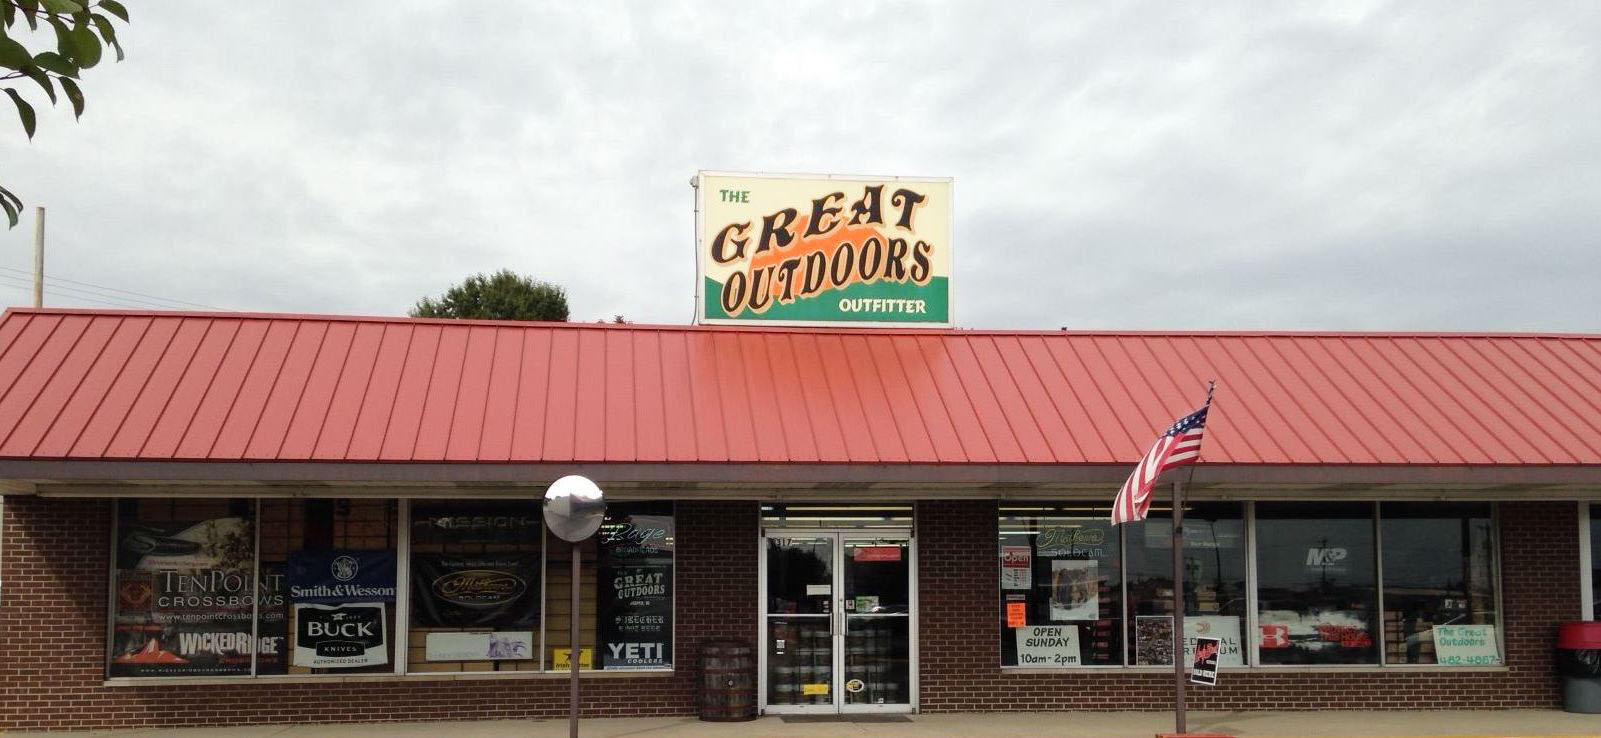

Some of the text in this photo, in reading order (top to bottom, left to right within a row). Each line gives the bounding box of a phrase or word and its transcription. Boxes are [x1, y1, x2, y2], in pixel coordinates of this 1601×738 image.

[720, 189, 750, 203] THE
[711, 185, 926, 263] GREAT
[722, 237, 931, 313] OUTDOORS
[839, 298, 928, 314] OUTFITTER
[614, 573, 663, 589] GREAT
[618, 585, 665, 599] OUTDOORS
[158, 594, 284, 608] CROSSBOWS
[307, 621, 375, 637] BUCK
[1033, 628, 1062, 637] OPEN
[1026, 638, 1069, 647] SUNDAY
[1440, 637, 1485, 647] Outdoors
[607, 642, 663, 660] YETI
[1054, 654, 1076, 665] 2pm
